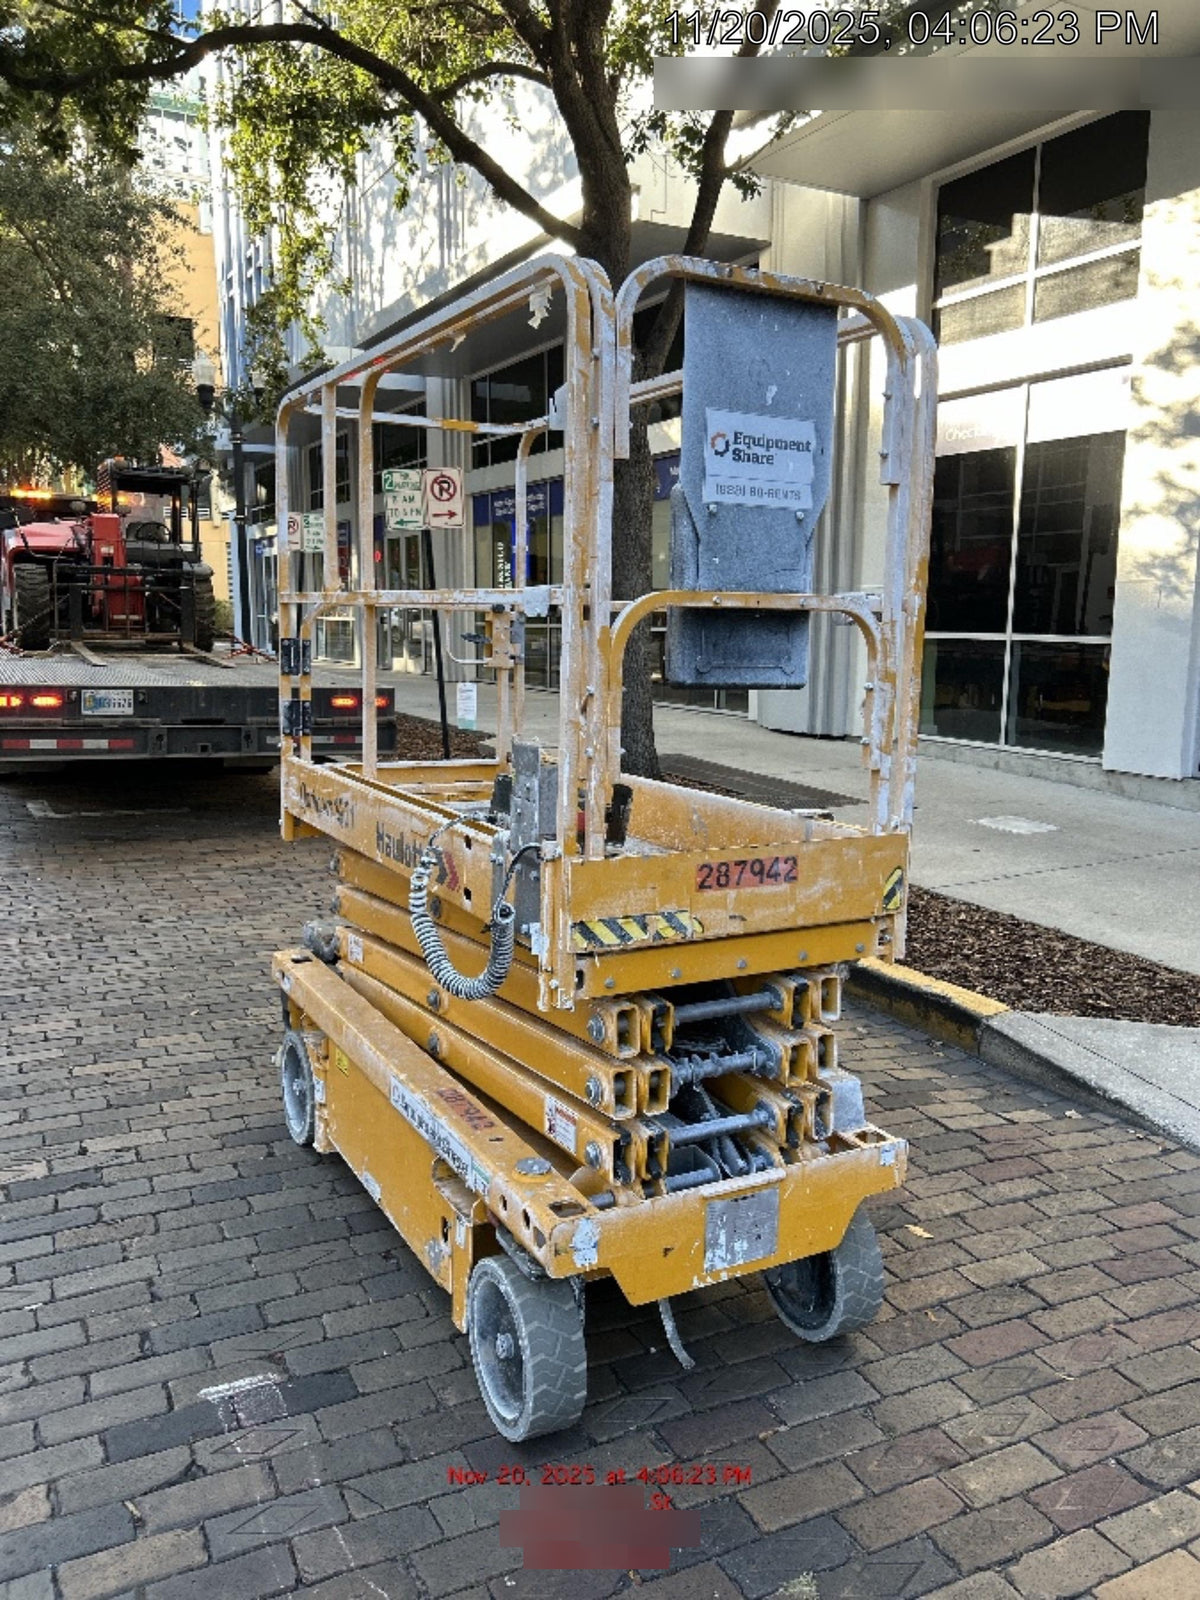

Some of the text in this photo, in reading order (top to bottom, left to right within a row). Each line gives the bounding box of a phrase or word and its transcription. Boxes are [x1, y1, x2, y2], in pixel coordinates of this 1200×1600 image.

[733, 431, 811, 452] Equipment
[732, 447, 774, 465] Share
[384, 474, 394, 490] 2
[698, 856, 798, 890] 287942
